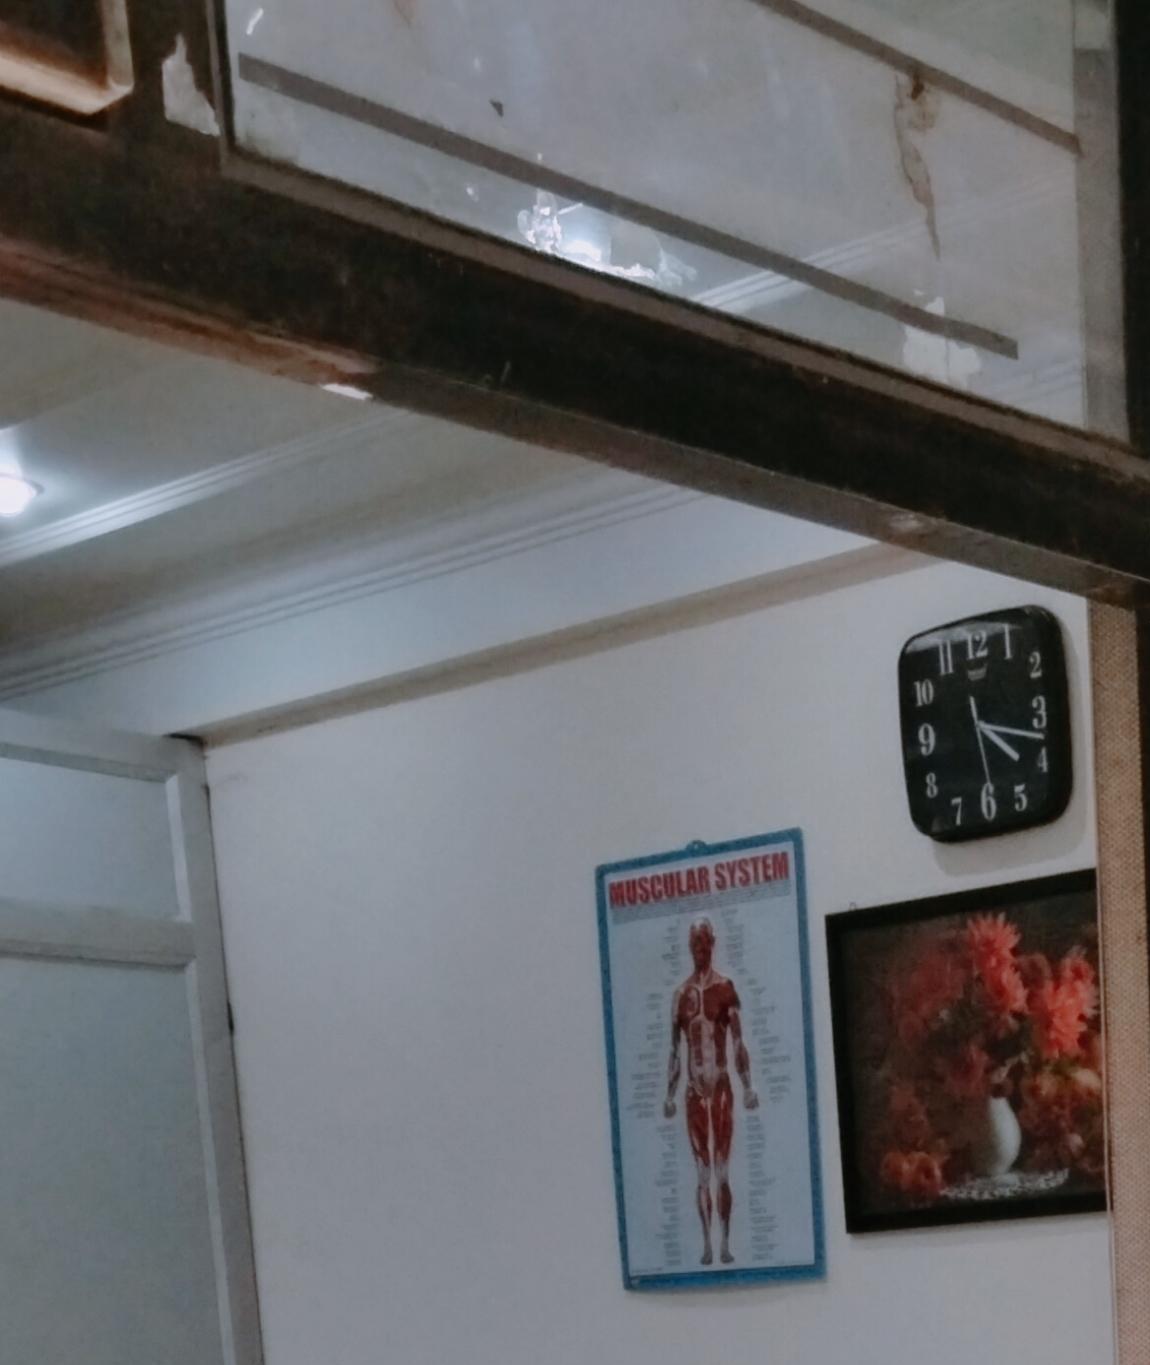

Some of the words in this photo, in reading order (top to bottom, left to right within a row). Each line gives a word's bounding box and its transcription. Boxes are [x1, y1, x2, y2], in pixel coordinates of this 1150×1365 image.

[965, 629, 989, 661] 12
[1003, 622, 1014, 660] 1
[938, 639, 955, 676] 11
[1029, 651, 1042, 679] 2
[913, 677, 935, 708] 10
[1031, 695, 1048, 730] 3
[917, 722, 937, 757] 9
[1036, 746, 1049, 774] 4
[925, 772, 939, 799] 8
[1013, 783, 1028, 812] 5
[951, 796, 963, 827] 7
[979, 782, 998, 822] 6
[608, 865, 711, 909] MUSCULAR
[714, 851, 790, 892] SYSTEM
